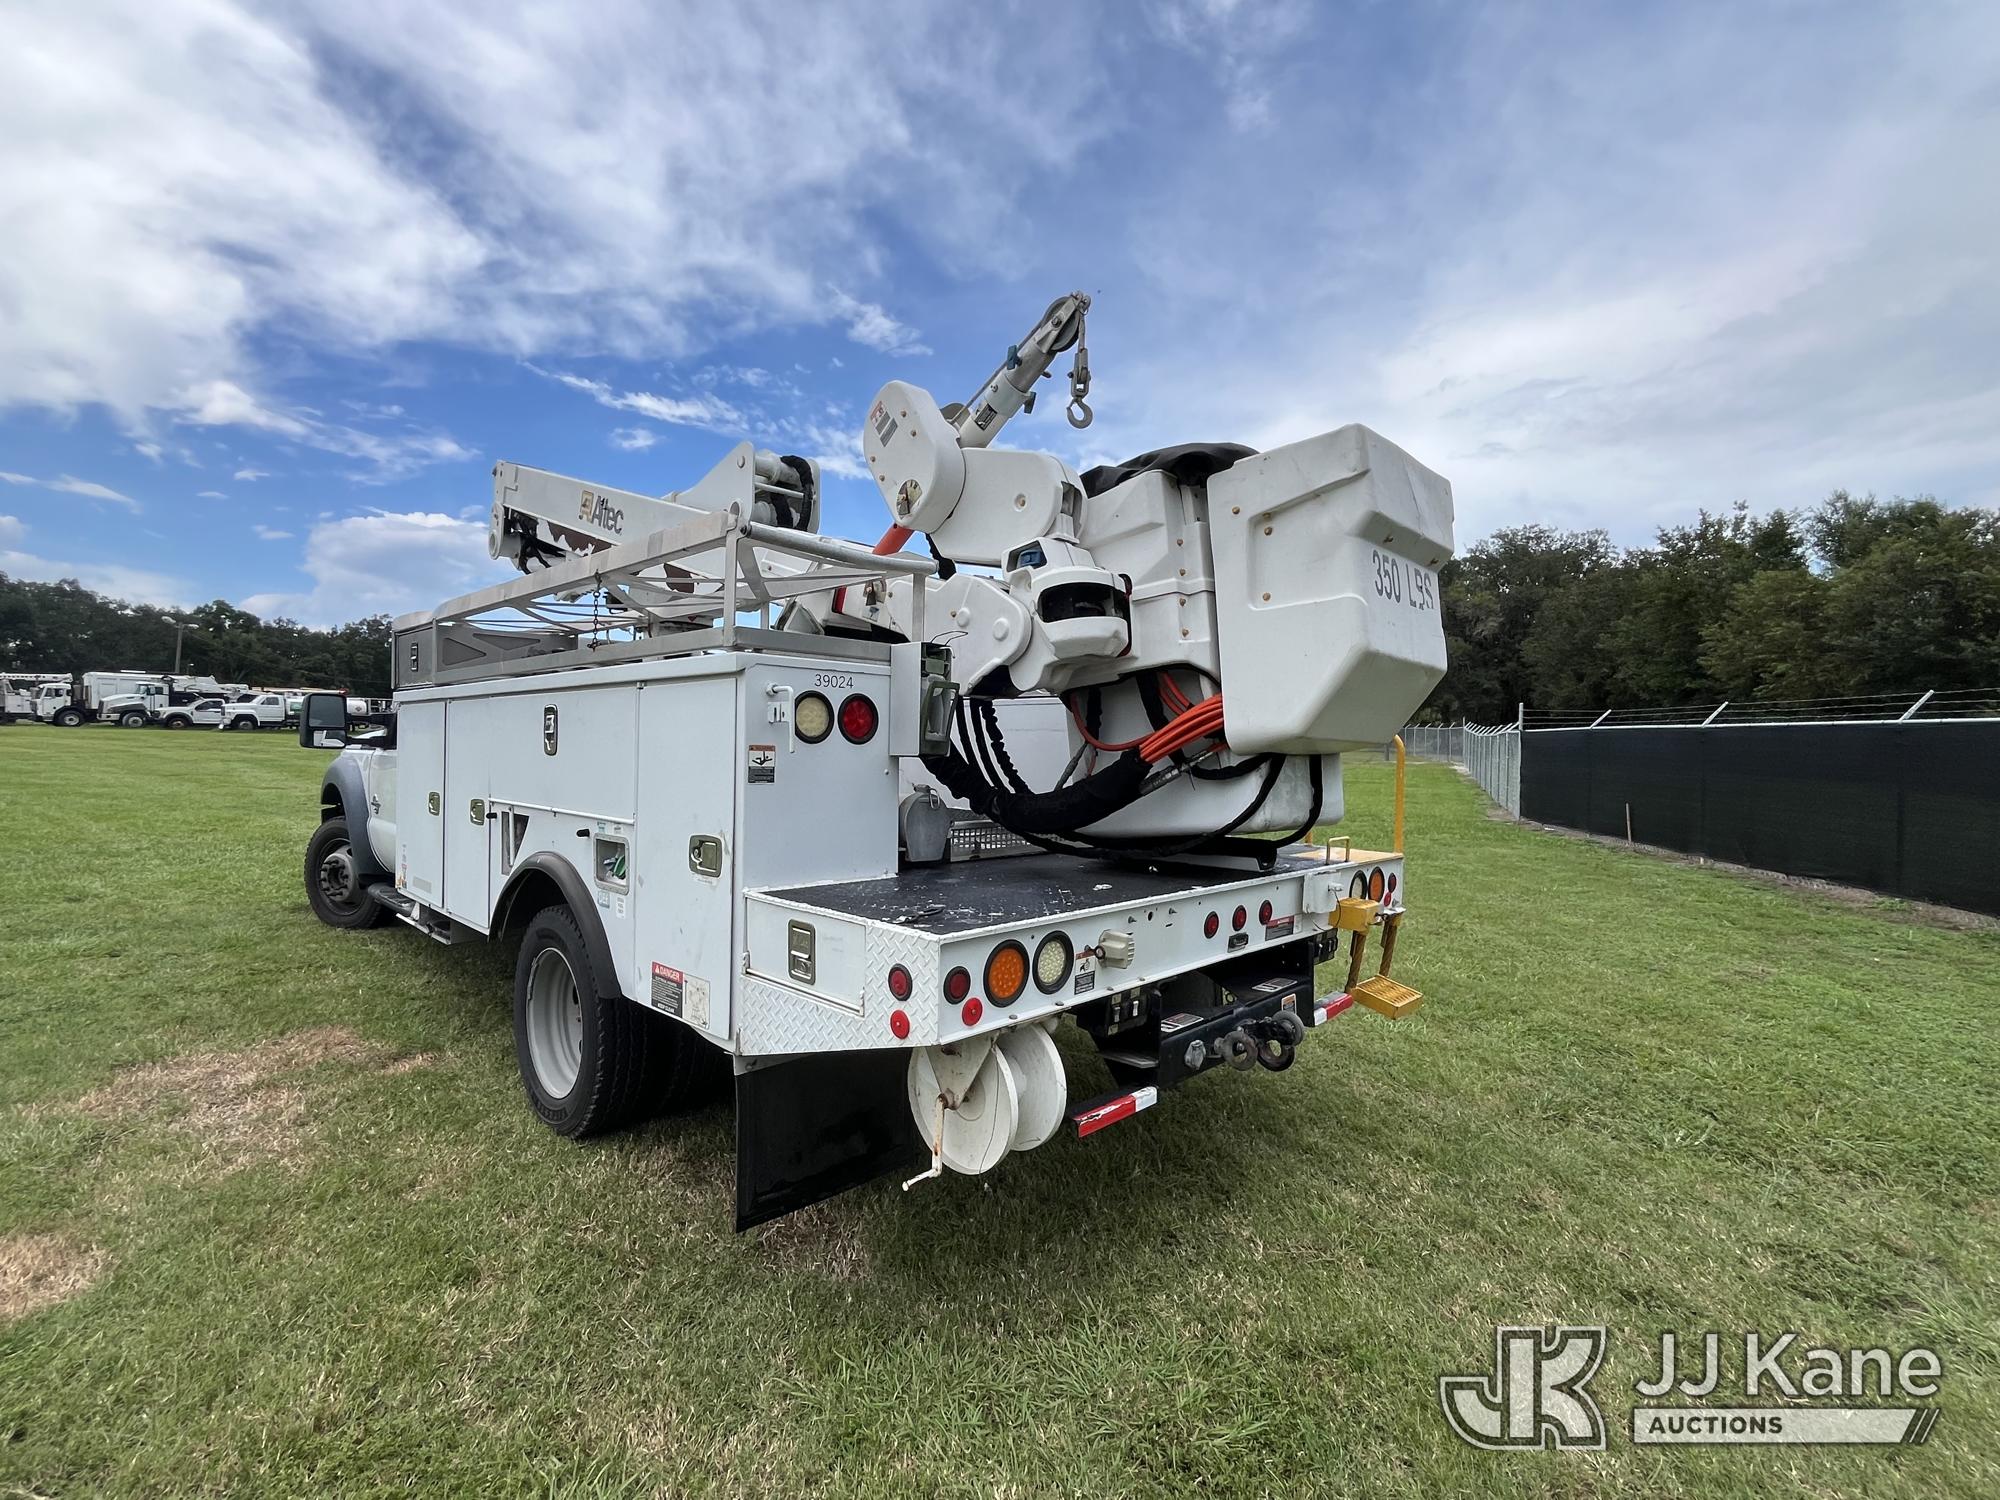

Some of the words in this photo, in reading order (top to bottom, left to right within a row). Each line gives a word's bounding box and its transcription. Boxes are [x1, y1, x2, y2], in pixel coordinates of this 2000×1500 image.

[592, 495, 624, 534] Altec
[1372, 550, 1401, 604] 350
[814, 673, 854, 689] 39024
